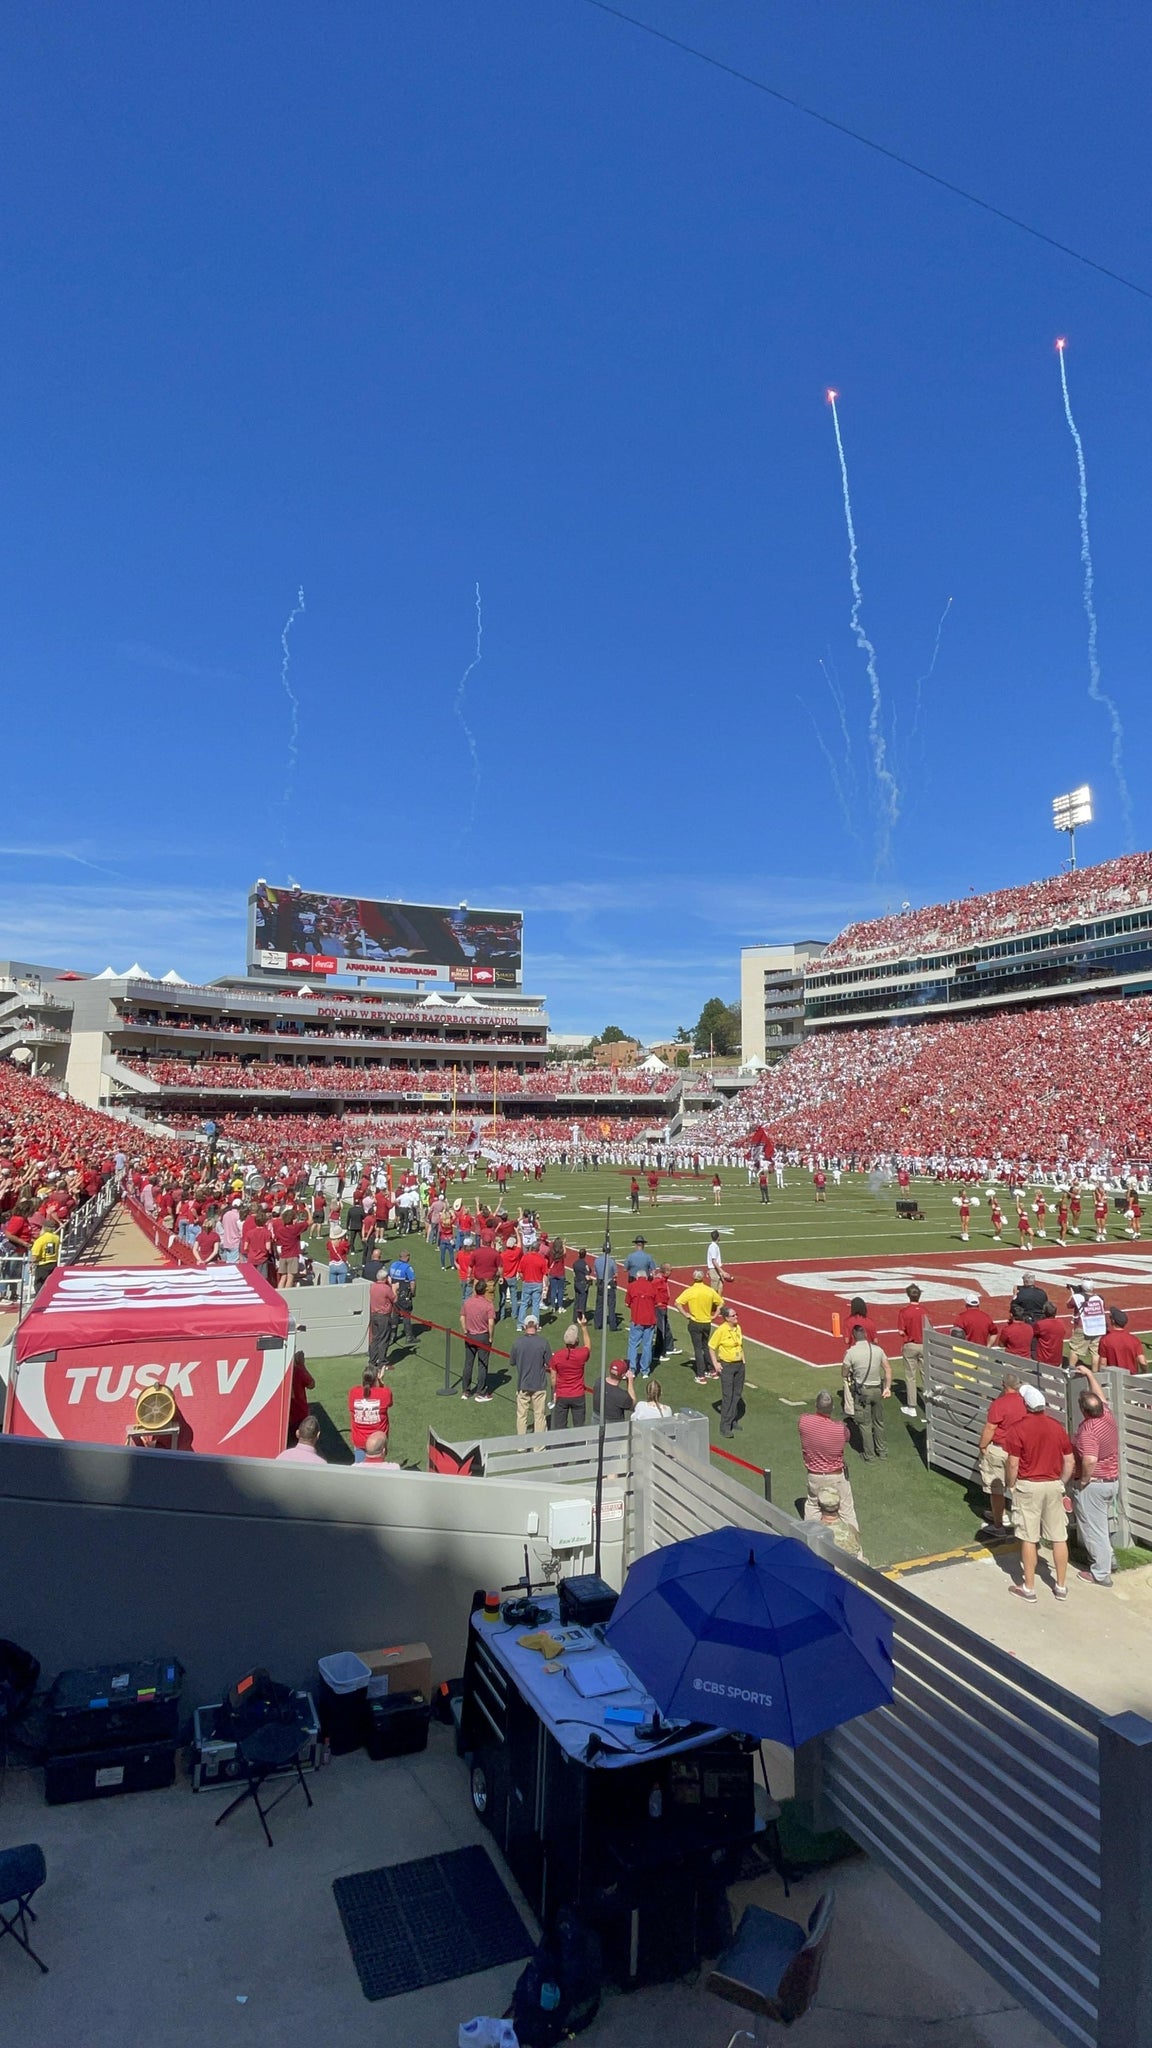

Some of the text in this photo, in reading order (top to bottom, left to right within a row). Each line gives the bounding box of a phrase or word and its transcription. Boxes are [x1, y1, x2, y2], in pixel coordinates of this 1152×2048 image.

[346, 963, 437, 976] ARKANSAS RAZORBACKS
[317, 1007, 357, 1018] DONALD
[370, 1011, 420, 1021] REYNOLDS
[422, 1013, 477, 1024] RAZORBACK
[479, 1016, 519, 1025] STADIUM
[65, 1358, 249, 1405] TUSK V
[703, 1681, 773, 1706] CBS SPORTS
